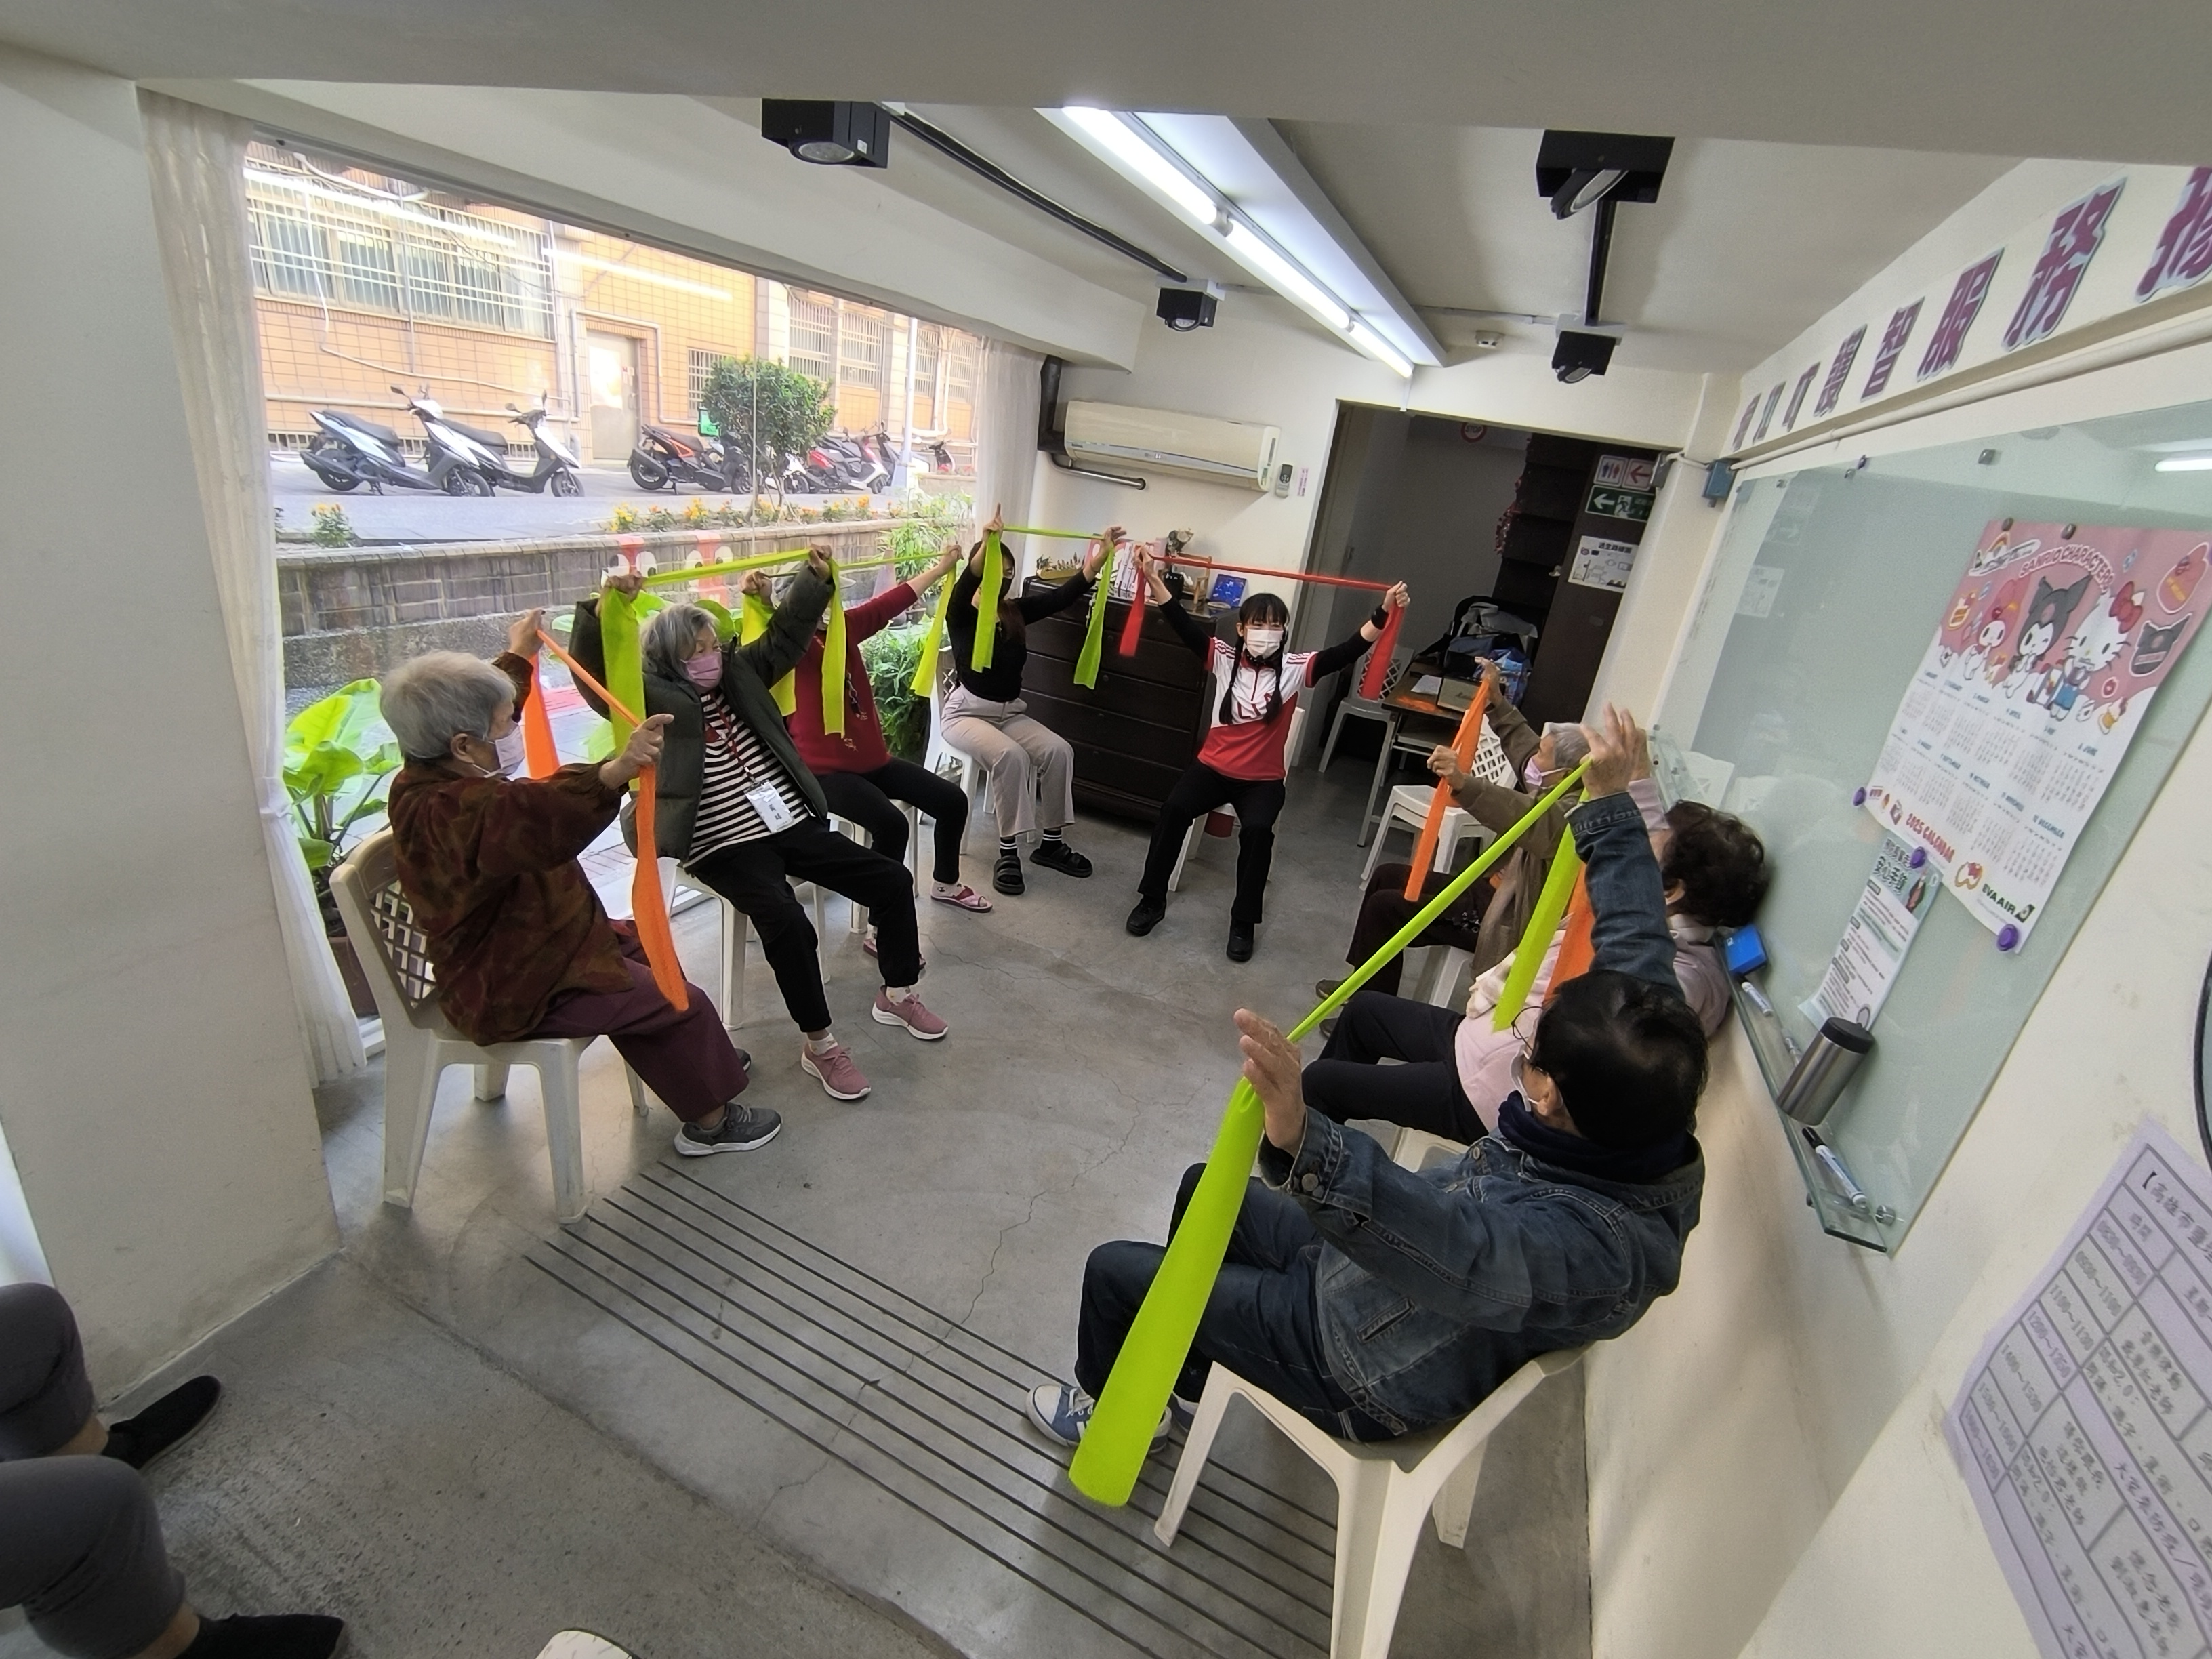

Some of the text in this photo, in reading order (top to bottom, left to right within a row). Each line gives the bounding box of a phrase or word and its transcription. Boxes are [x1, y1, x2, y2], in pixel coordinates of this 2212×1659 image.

[1465, 424, 1483, 434] STOP
[2020, 545, 2114, 590] SANRIO CHARACTERS
[1905, 813, 1925, 835] 2025
[1922, 825, 1956, 863] CALENDAR
[1981, 883, 1998, 902] EVA
[1996, 898, 2017, 916] AIR
